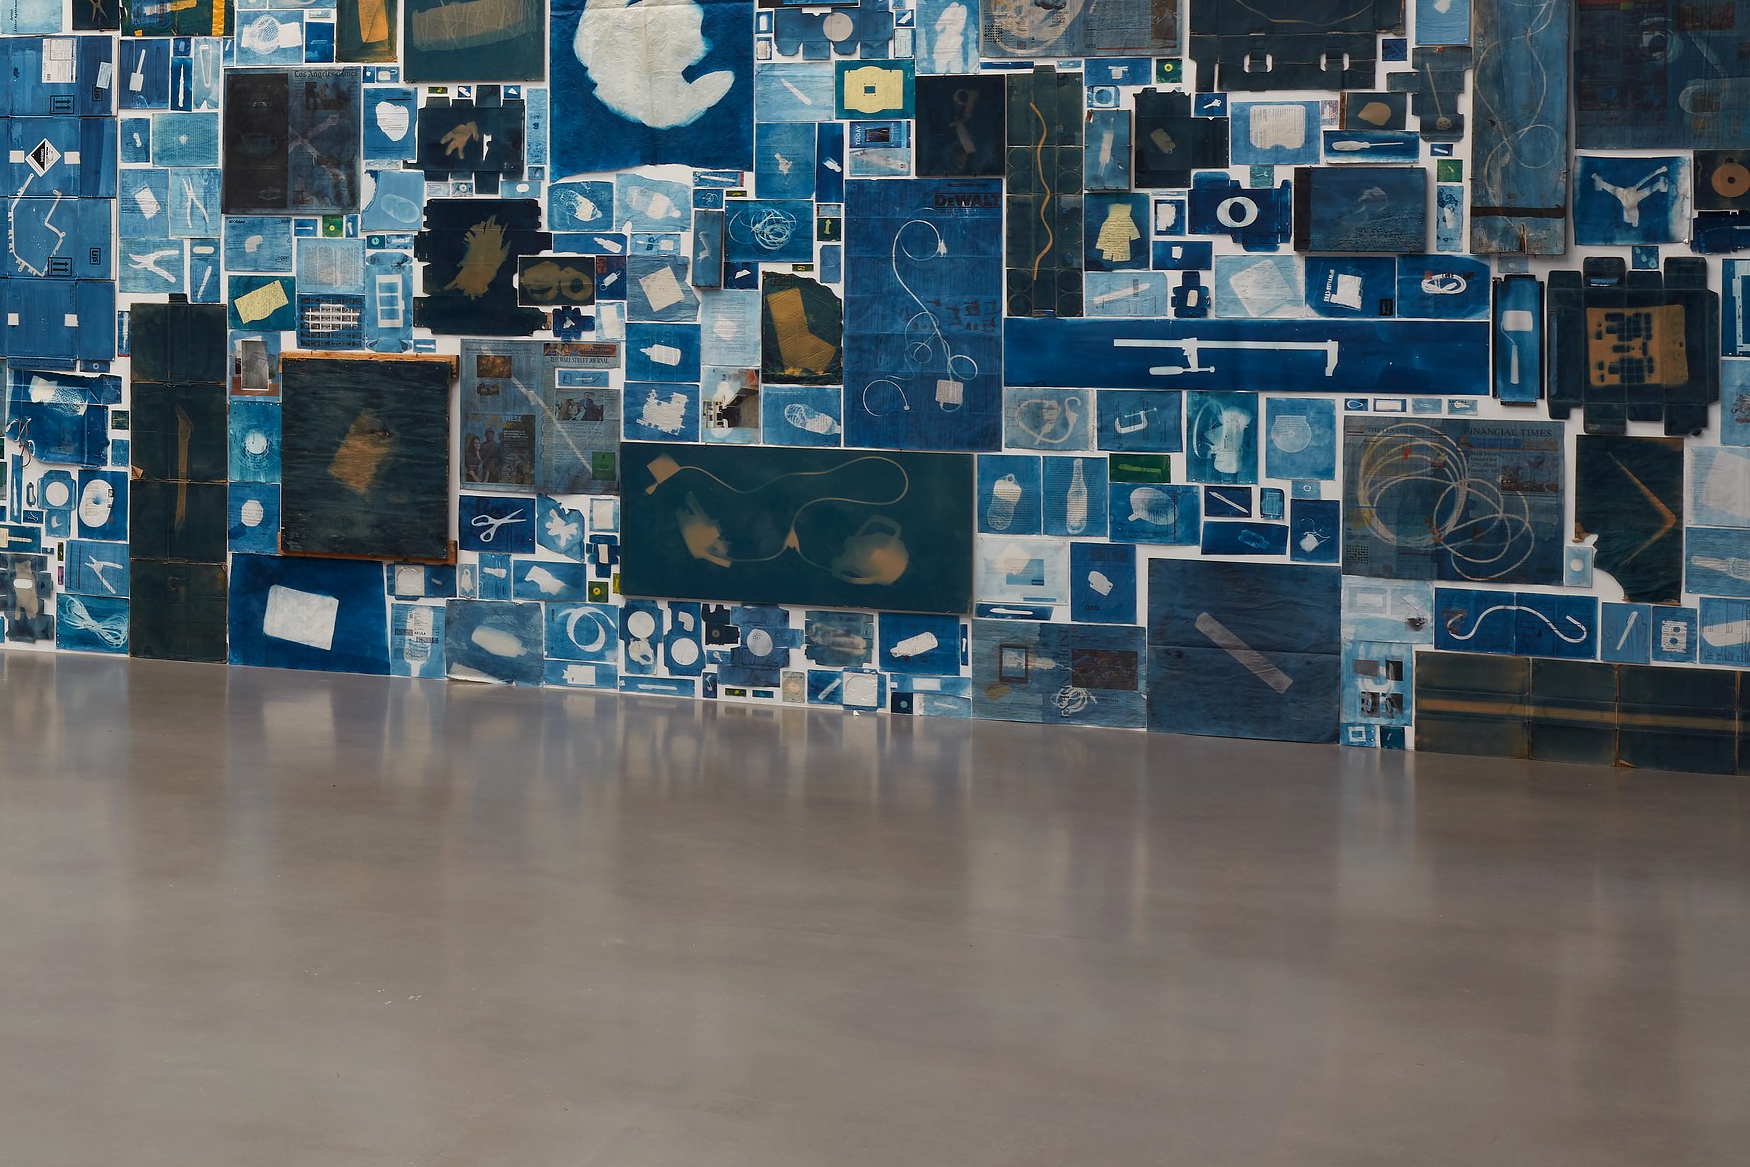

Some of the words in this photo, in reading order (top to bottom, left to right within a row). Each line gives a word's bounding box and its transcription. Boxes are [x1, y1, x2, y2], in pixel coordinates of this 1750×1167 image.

[307, 70, 335, 79] Angeles
[1463, 428, 1517, 437] FINANCIAL
[1520, 428, 1553, 438] TIMES
